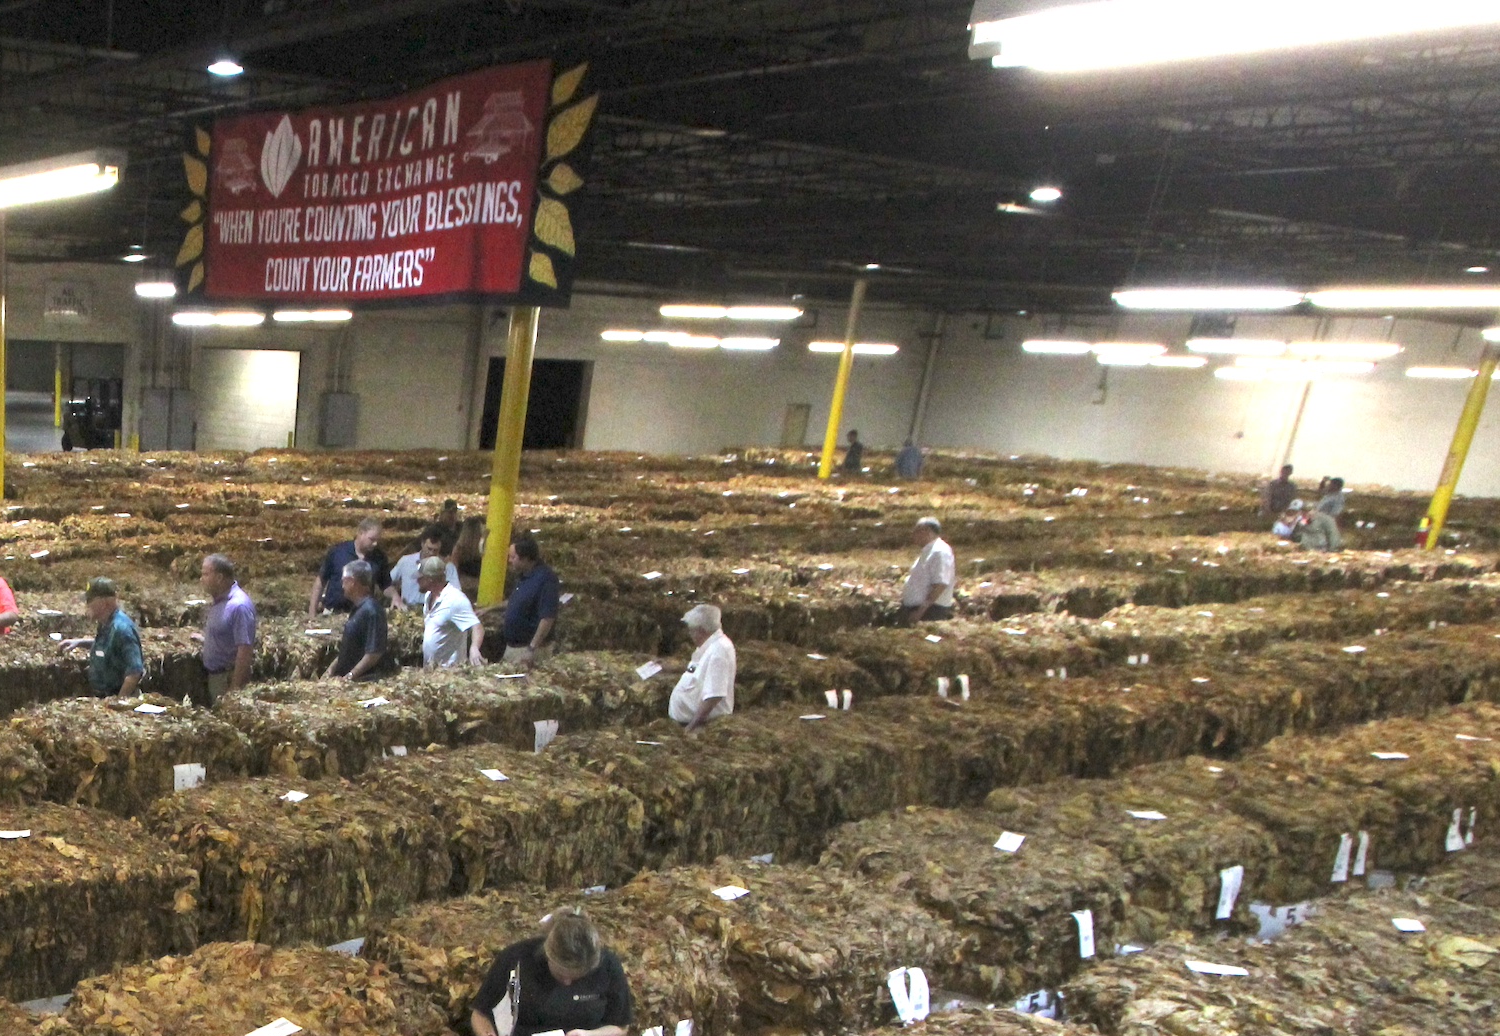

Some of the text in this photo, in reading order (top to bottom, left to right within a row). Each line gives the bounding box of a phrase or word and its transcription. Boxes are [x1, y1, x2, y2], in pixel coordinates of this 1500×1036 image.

[307, 90, 461, 166] AMERICAN
[303, 152, 455, 198] TOBACCO EXCHANGE
[213, 181, 523, 244] "WHEN YOU'RE COUNTING YOUR BLESSINGS,
[264, 247, 436, 292] COUNT YOUR FARMERS"
